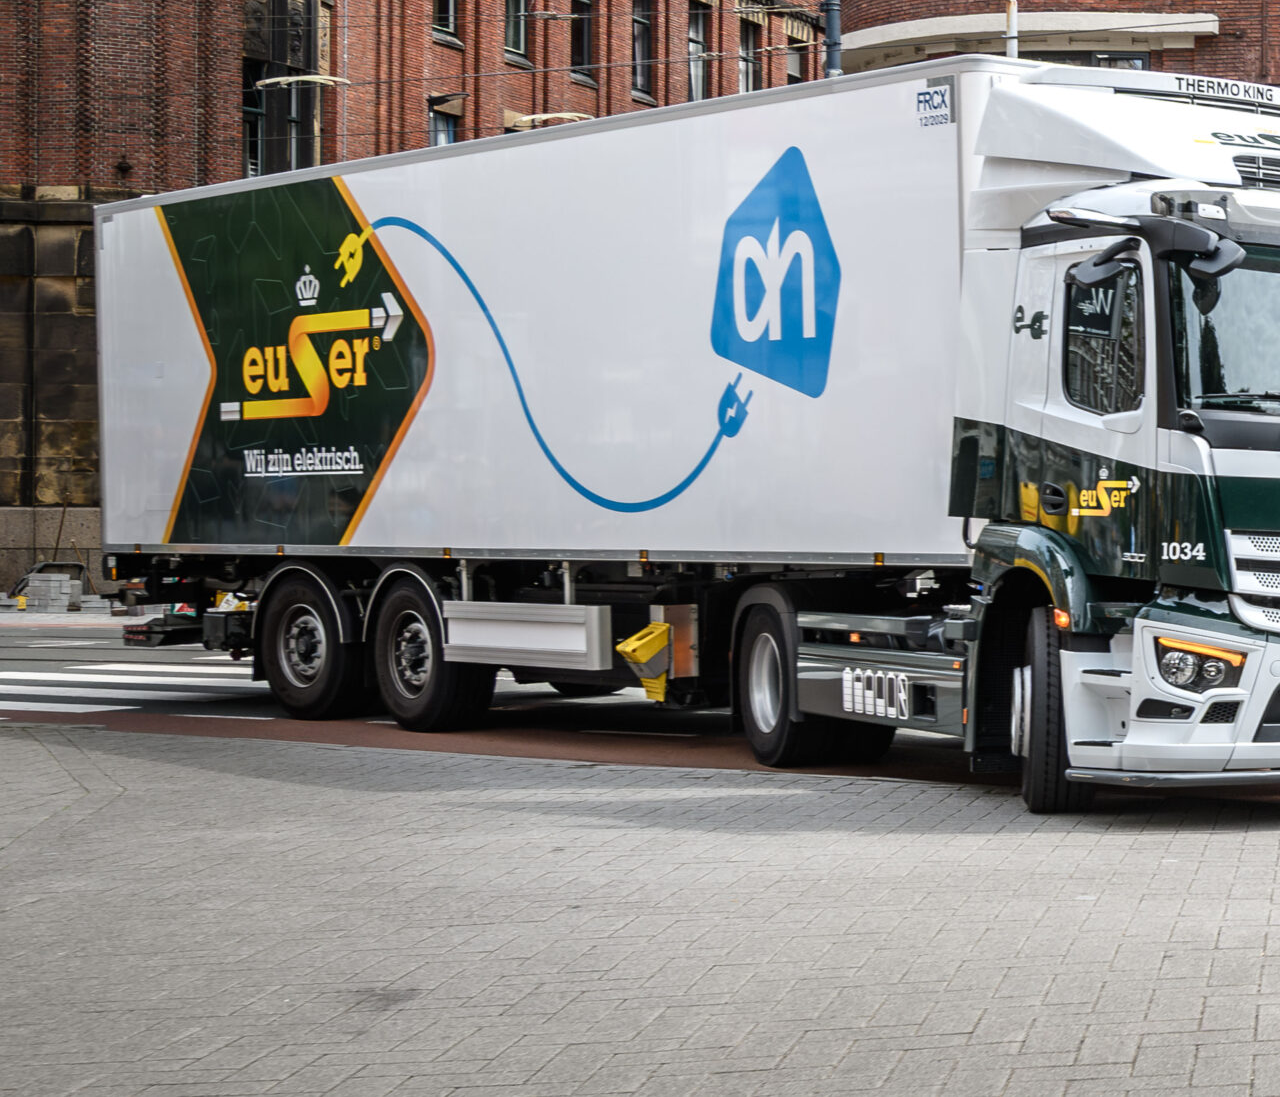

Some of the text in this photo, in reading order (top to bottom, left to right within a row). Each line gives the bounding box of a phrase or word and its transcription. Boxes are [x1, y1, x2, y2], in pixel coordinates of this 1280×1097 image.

[917, 89, 948, 112] FRCX
[1175, 77, 1273, 102] THERMO KING
[919, 113, 948, 127] 12/2029
[243, 445, 364, 477] Wij zijn elektrisch.
[1161, 542, 1206, 560] 1034
